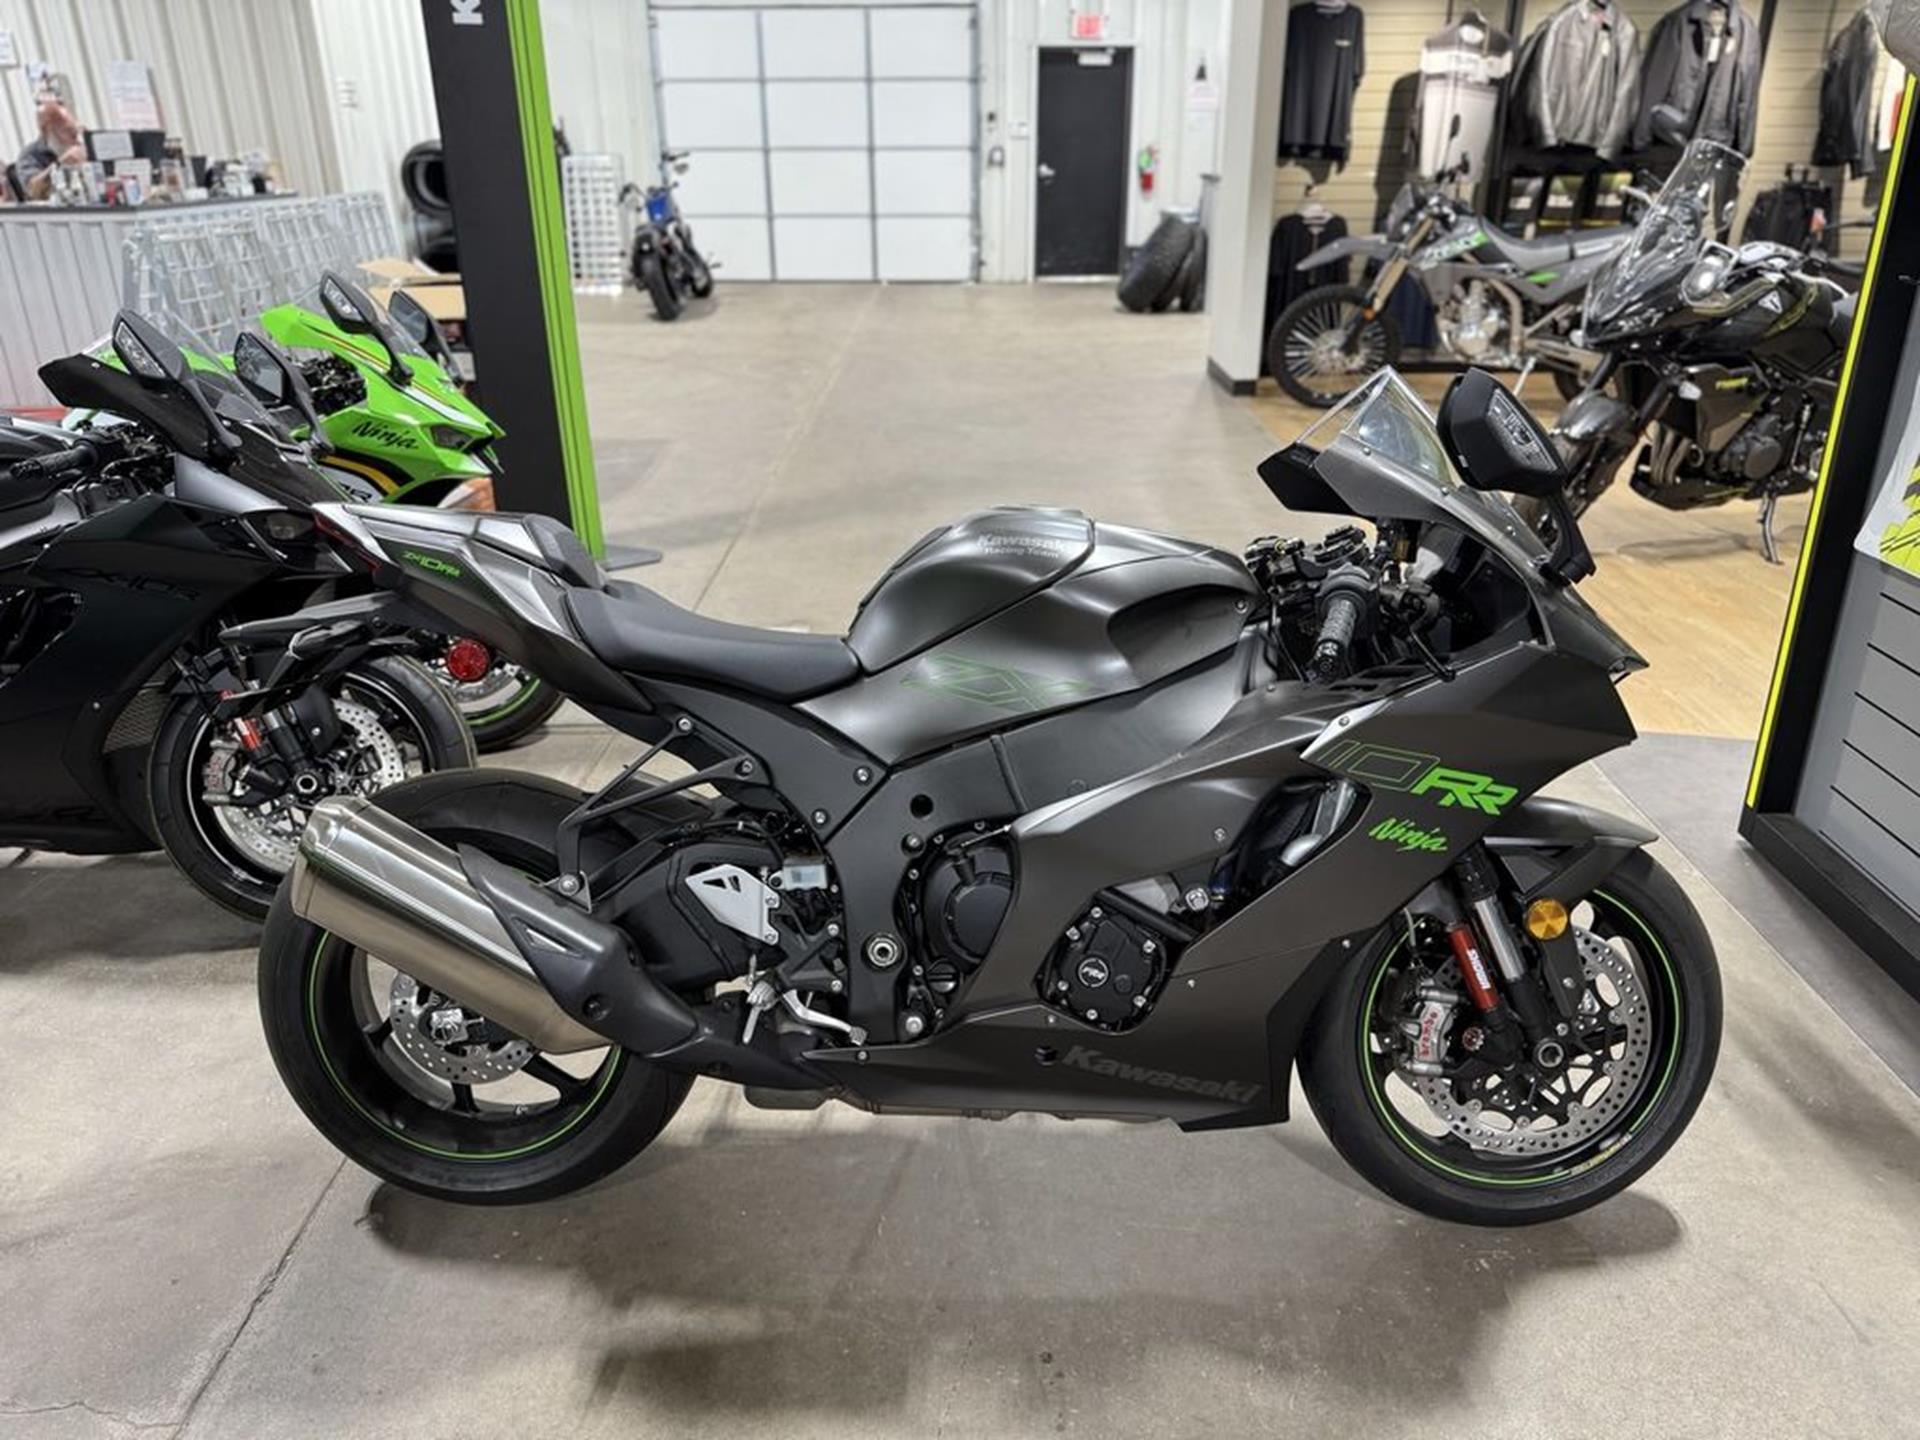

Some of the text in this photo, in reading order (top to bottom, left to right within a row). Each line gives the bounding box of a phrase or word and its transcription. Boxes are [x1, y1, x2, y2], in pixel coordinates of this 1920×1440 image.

[352, 420, 420, 449] Ninja
[985, 546, 1059, 558] Racing Team
[1368, 817, 1449, 852] Ninja
[1062, 1045, 1262, 1103] Kawasaki
